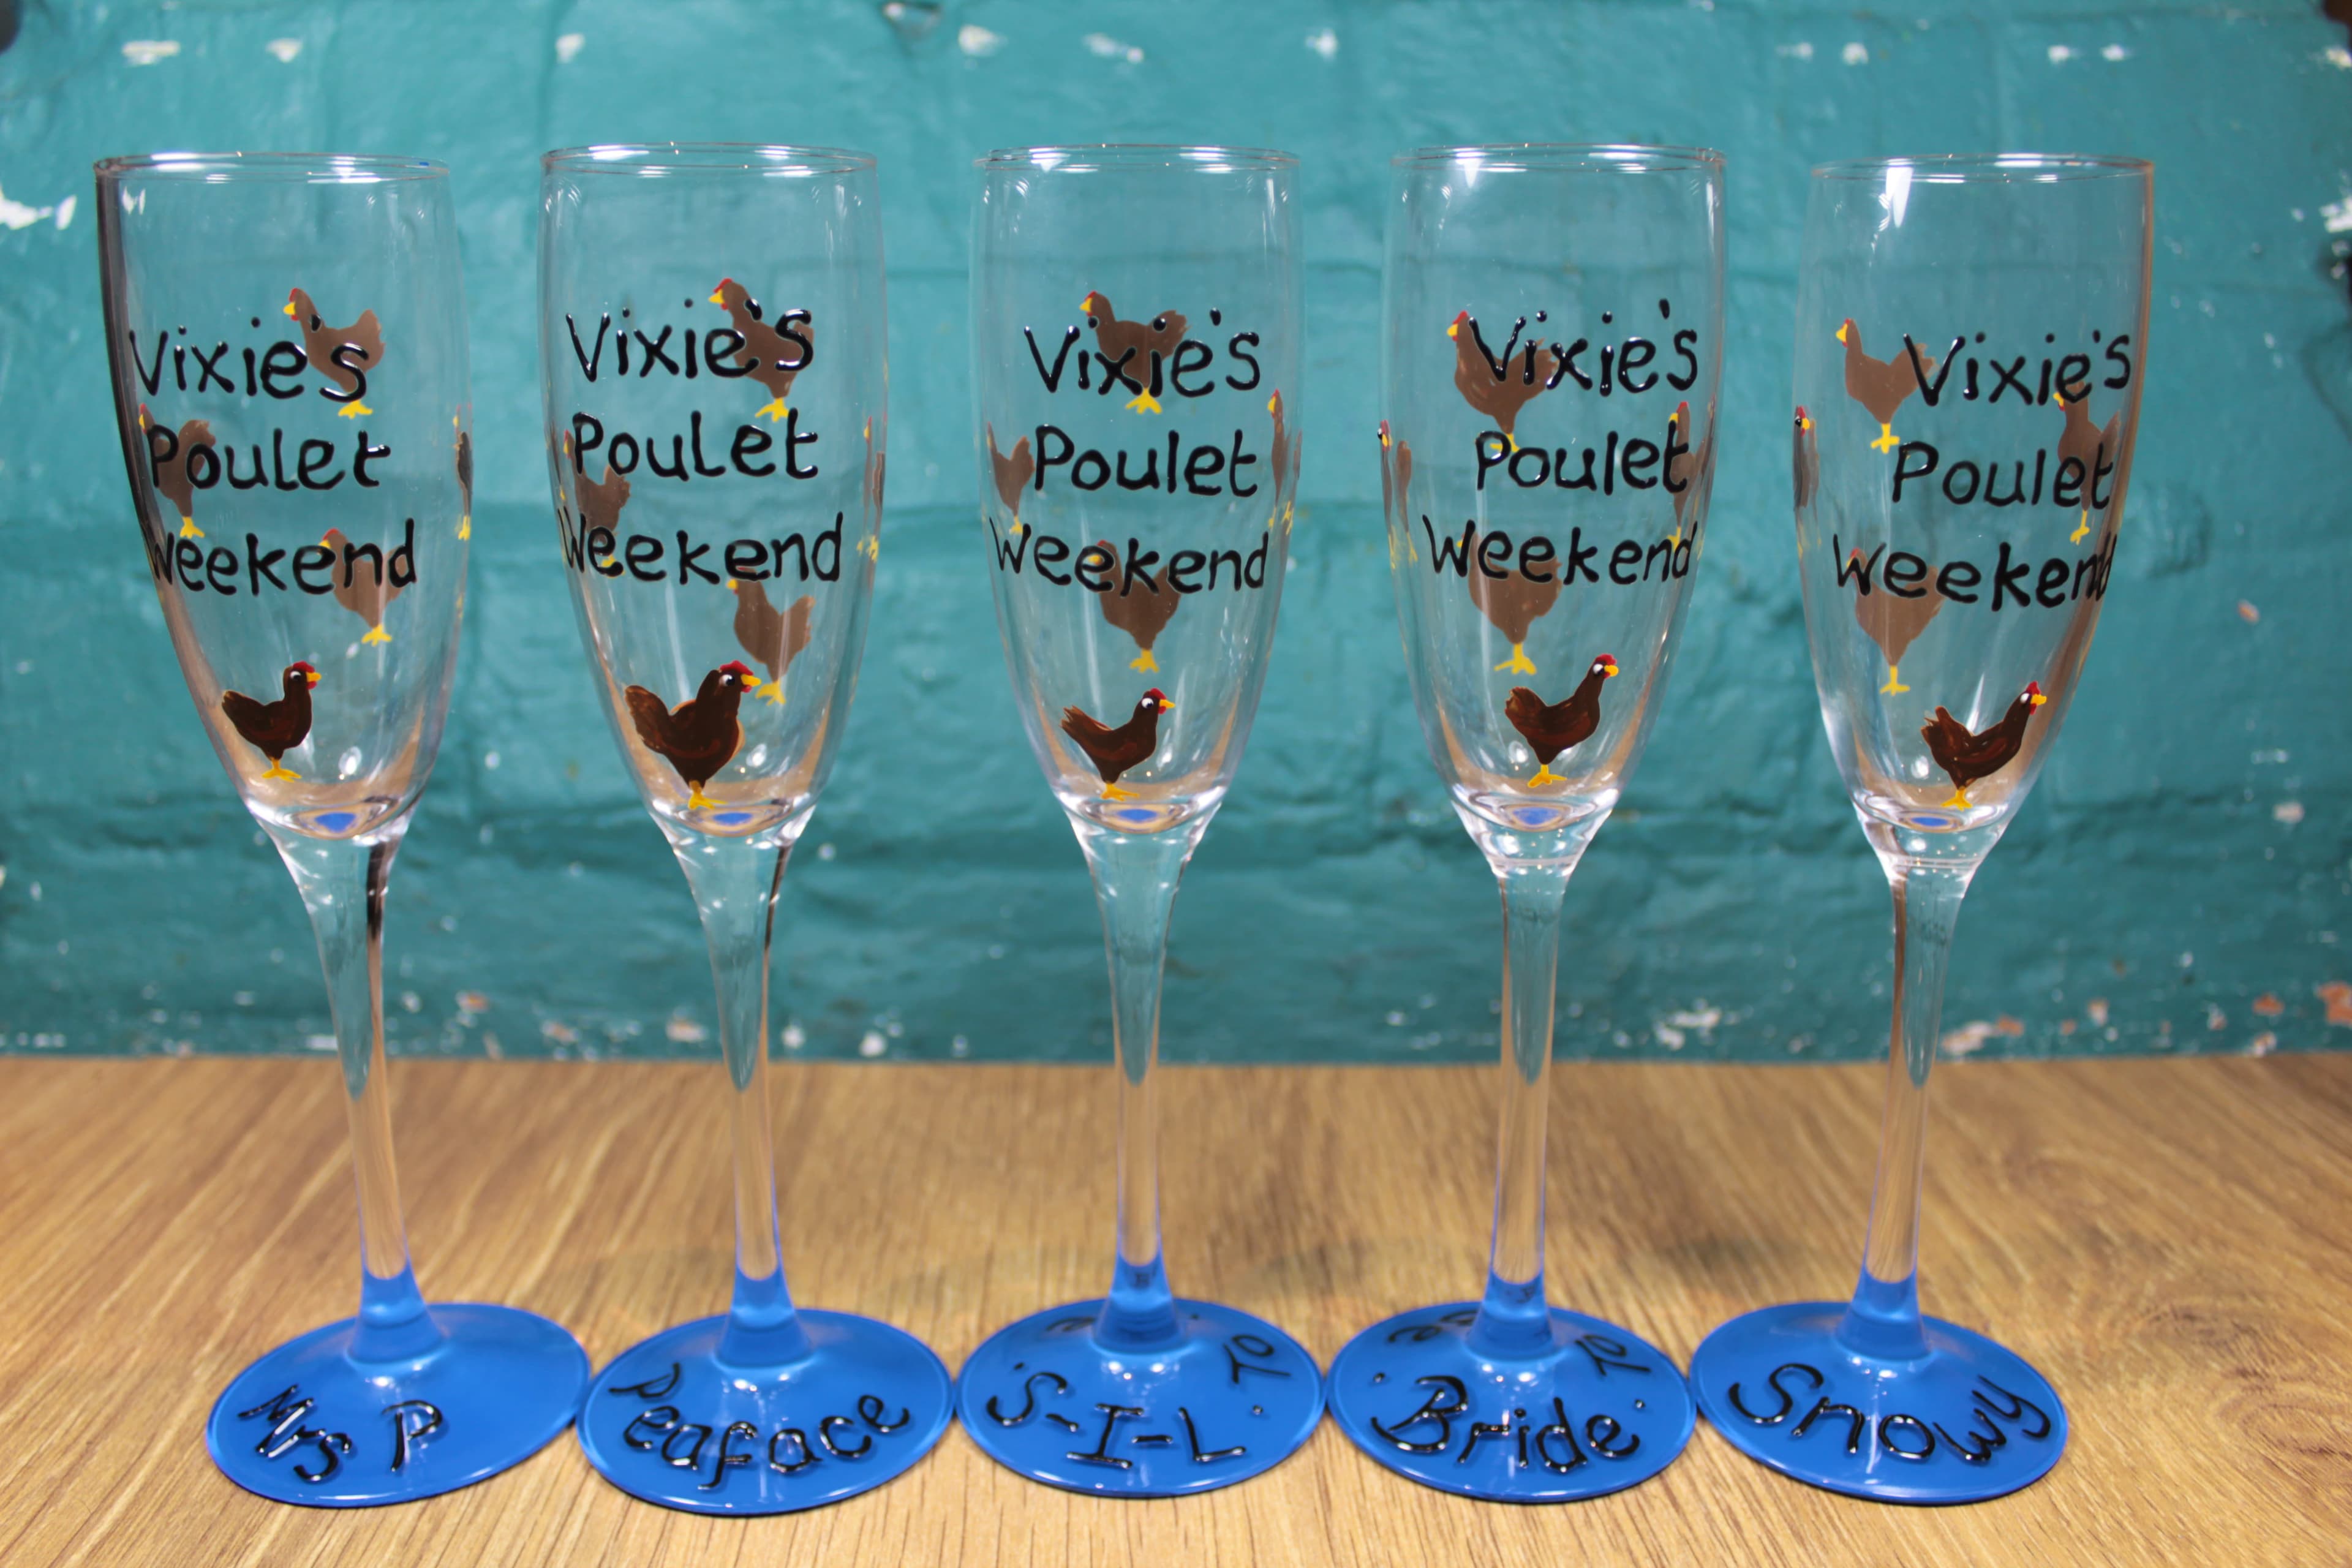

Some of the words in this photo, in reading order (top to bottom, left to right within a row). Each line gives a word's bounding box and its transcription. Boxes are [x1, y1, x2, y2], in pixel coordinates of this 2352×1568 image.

[129, 314, 370, 402] Vixie's
[565, 298, 814, 382] Vixie's
[1023, 307, 1261, 398] Vixie's
[1468, 298, 1698, 396] Vixie's
[1903, 330, 2132, 406] Vixie's
[146, 424, 391, 491] Poulet
[572, 408, 818, 481] Poulet
[1034, 424, 1258, 497] Poulet
[1476, 420, 1689, 496] Poulet
[1892, 440, 2114, 510] Poulet
[145, 518, 417, 597] Weekend
[557, 506, 843, 585] Weekend
[989, 516, 1268, 597] Weekend
[1422, 514, 1698, 585] Weekend
[381, 1399, 443, 1474] P
[608, 1362, 911, 1491] Peaface
[1370, 1375, 1640, 1474] Bride
